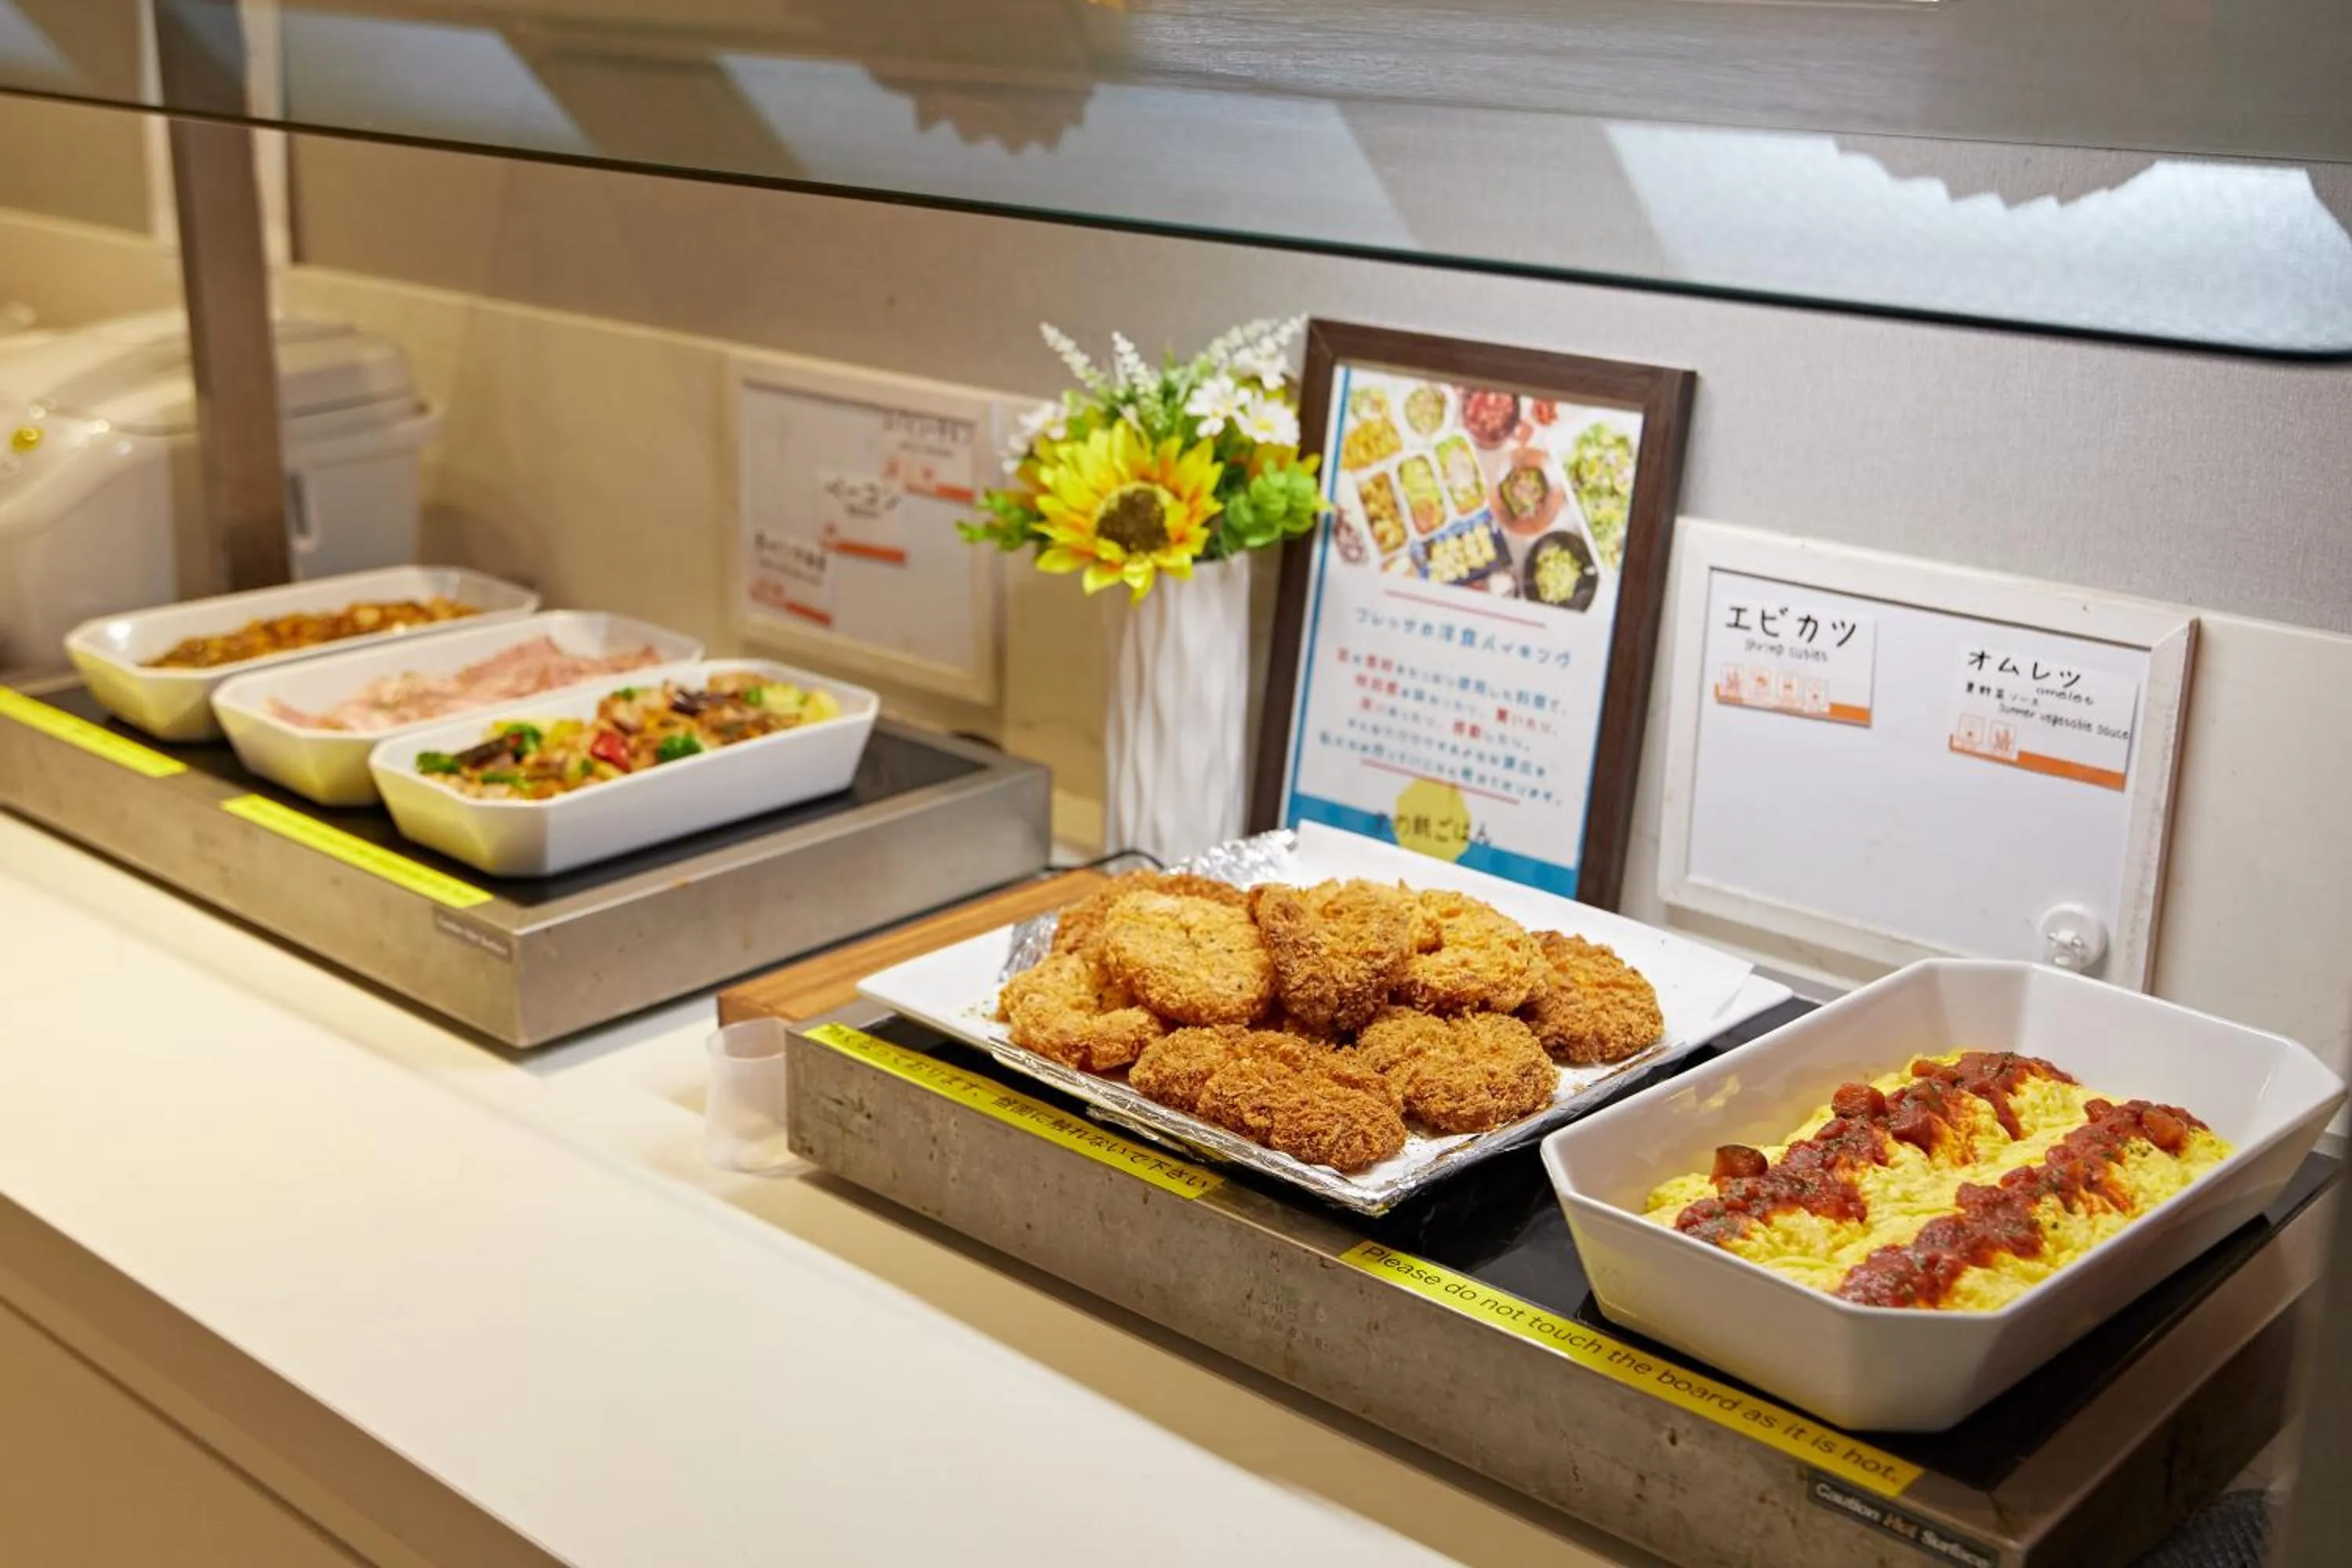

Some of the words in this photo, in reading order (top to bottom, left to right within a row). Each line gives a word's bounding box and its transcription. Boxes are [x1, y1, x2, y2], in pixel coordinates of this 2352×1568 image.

[1726, 607, 1857, 648] エビカツ
[1968, 650, 2081, 688] オムレツ
[1363, 1246, 1441, 1287] Please
[1445, 1281, 1477, 1301] do
[1480, 1297, 1528, 1322] not
[1528, 1316, 1602, 1356] touch
[1606, 1348, 1653, 1375] the
[1657, 1369, 1740, 1412] board
[1742, 1409, 1777, 1429] as
[1783, 1423, 1807, 1441] it
[1810, 1433, 1838, 1454] is
[1842, 1448, 1898, 1483] hot.
[1816, 1482, 1881, 1521] Caution
